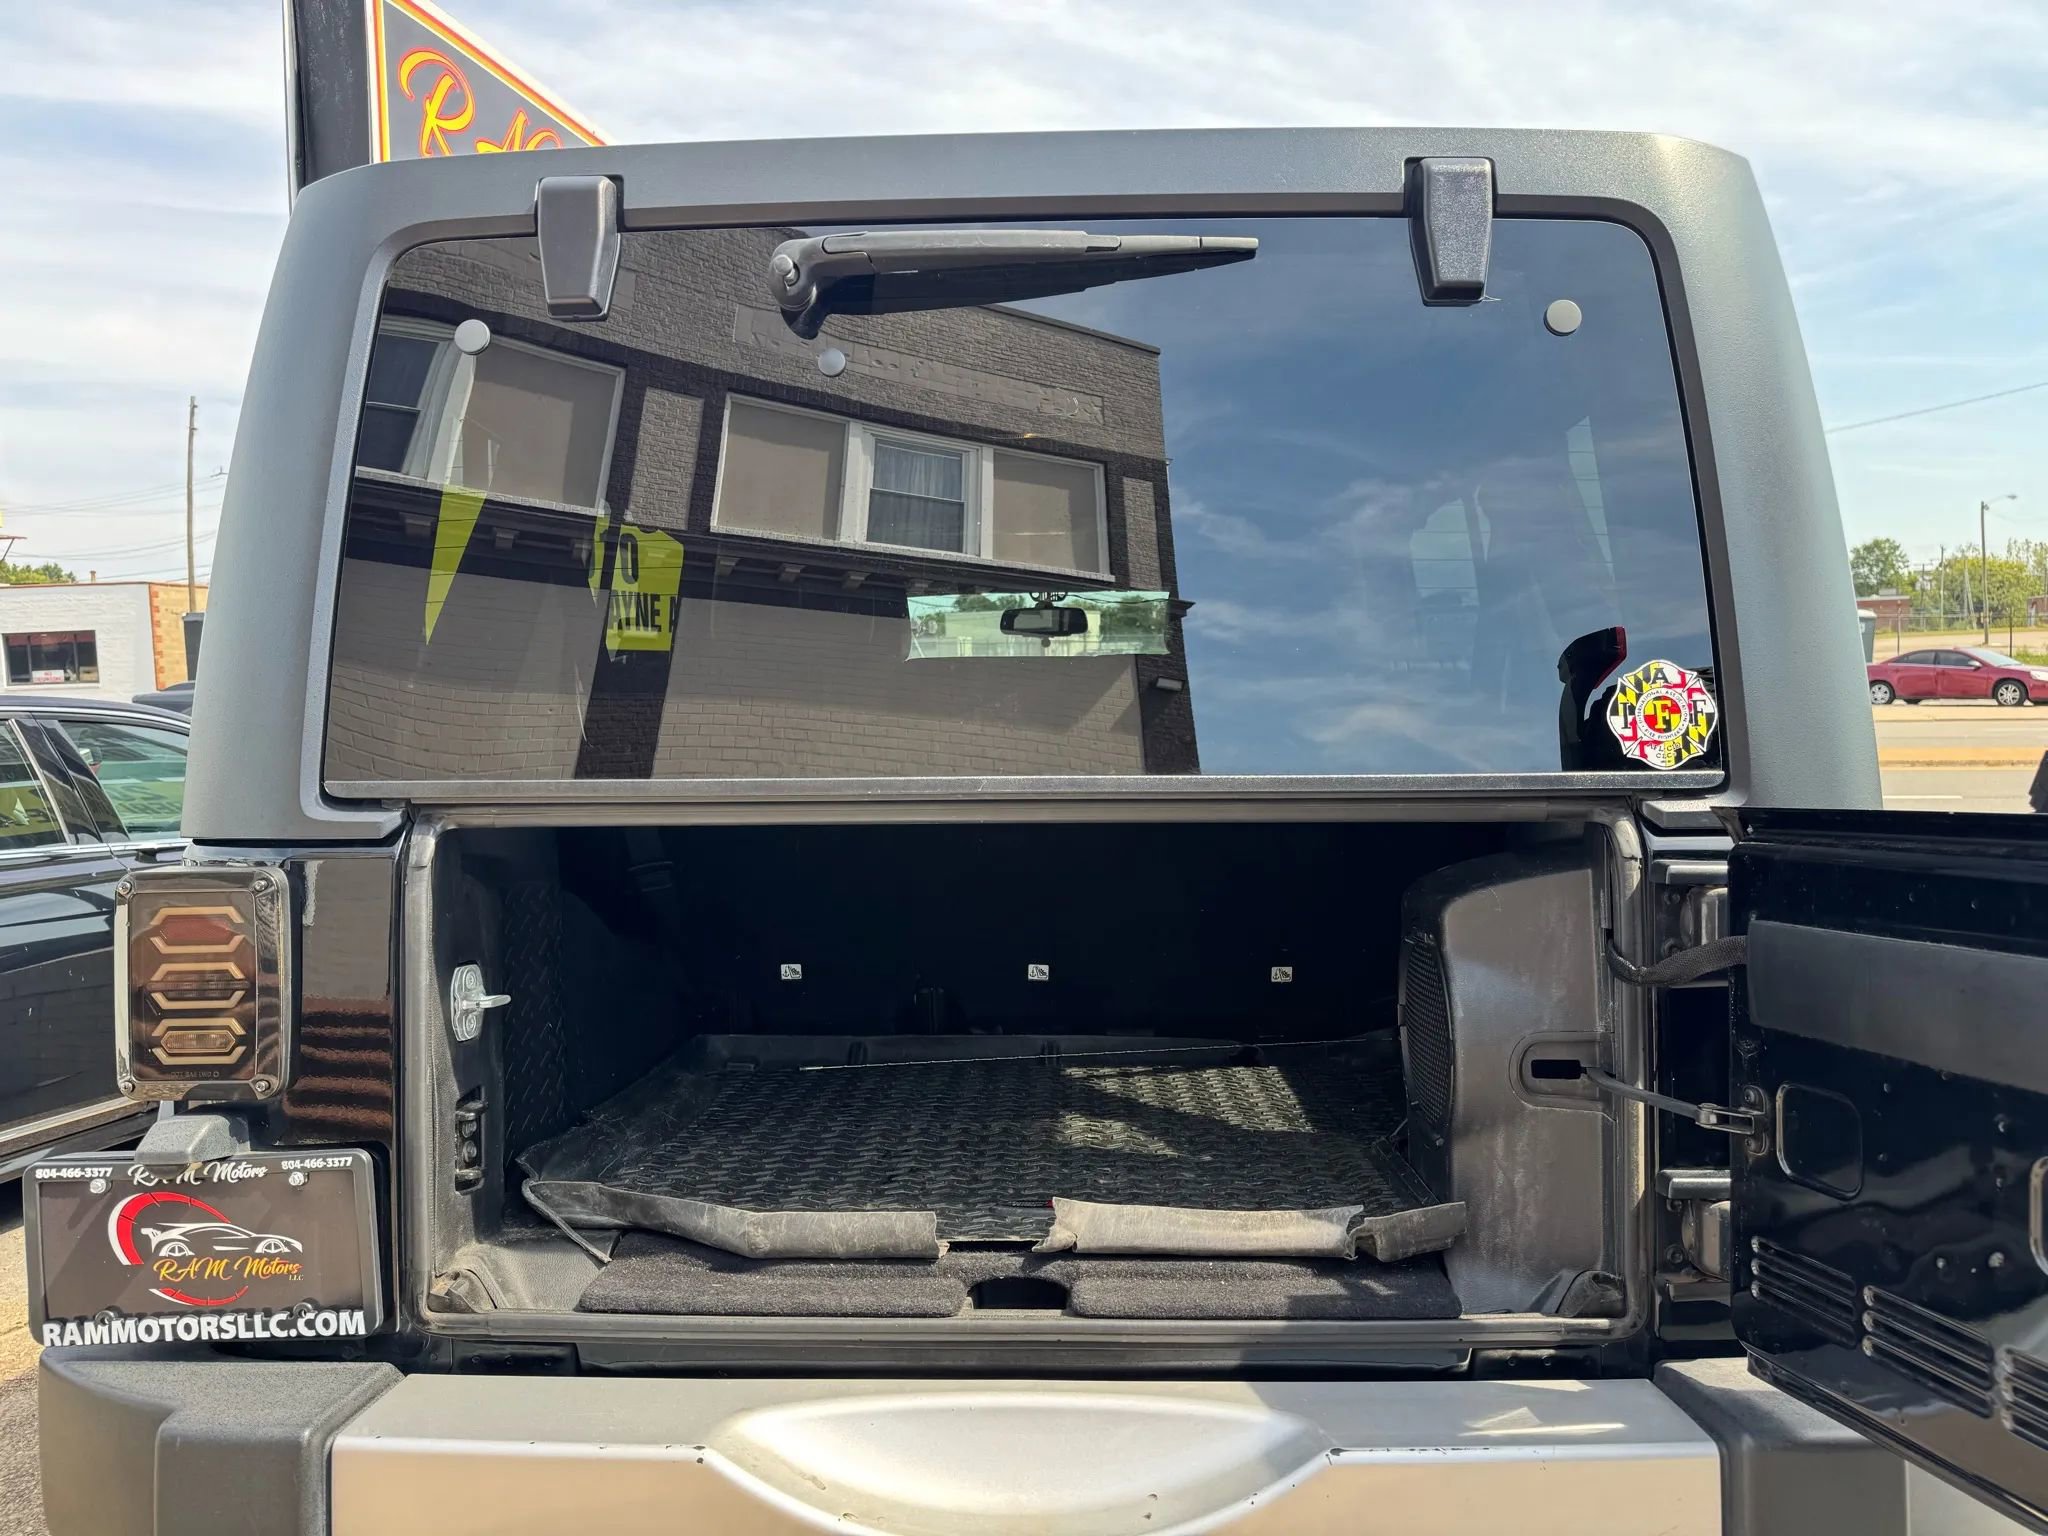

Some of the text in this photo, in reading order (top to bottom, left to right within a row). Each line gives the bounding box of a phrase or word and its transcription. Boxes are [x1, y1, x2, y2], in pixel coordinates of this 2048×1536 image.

[1652, 699, 1672, 729] F
[35, 1167, 112, 1179] 804-466-3377
[205, 1162, 269, 1184] Motors
[281, 1156, 353, 1170] 804-466-3377
[153, 1256, 304, 1282] RAM Motors
[42, 1310, 367, 1348] RAMMOTORSLLC.COM
